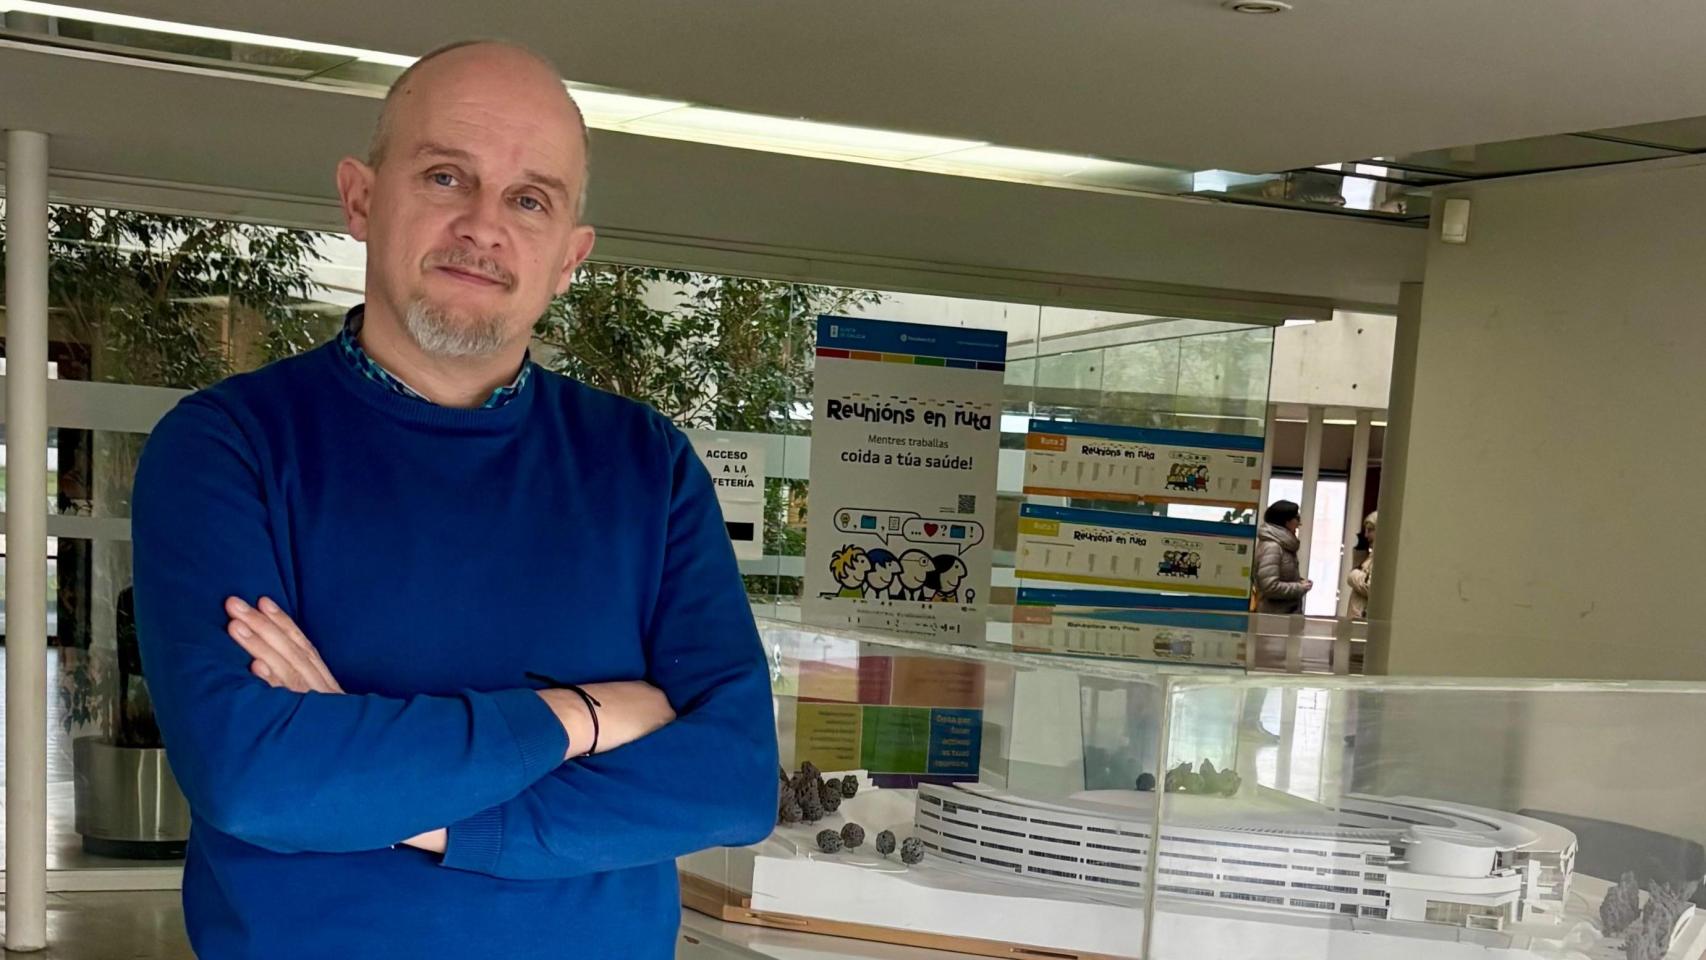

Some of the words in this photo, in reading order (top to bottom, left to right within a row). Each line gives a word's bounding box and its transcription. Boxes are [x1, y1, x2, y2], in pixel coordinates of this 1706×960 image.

[827, 399, 915, 425] Reunións
[924, 408, 946, 428] en
[954, 410, 992, 431] ruta
[867, 434, 906, 446] Mentres
[908, 437, 949, 449] traballas
[706, 449, 748, 460] ACCESO
[841, 449, 880, 464] coida
[884, 454, 892, 465] a
[897, 452, 921, 467] túa
[925, 455, 973, 470] saúde!
[1081, 445, 1121, 458] Reunións
[1124, 448, 1135, 459] en
[1138, 450, 1155, 461] ruta
[723, 464, 730, 473] A
[734, 464, 747, 473] LA
[1073, 530, 1113, 543] Reunións
[1116, 535, 1127, 545] en
[1129, 536, 1147, 547] ruta
